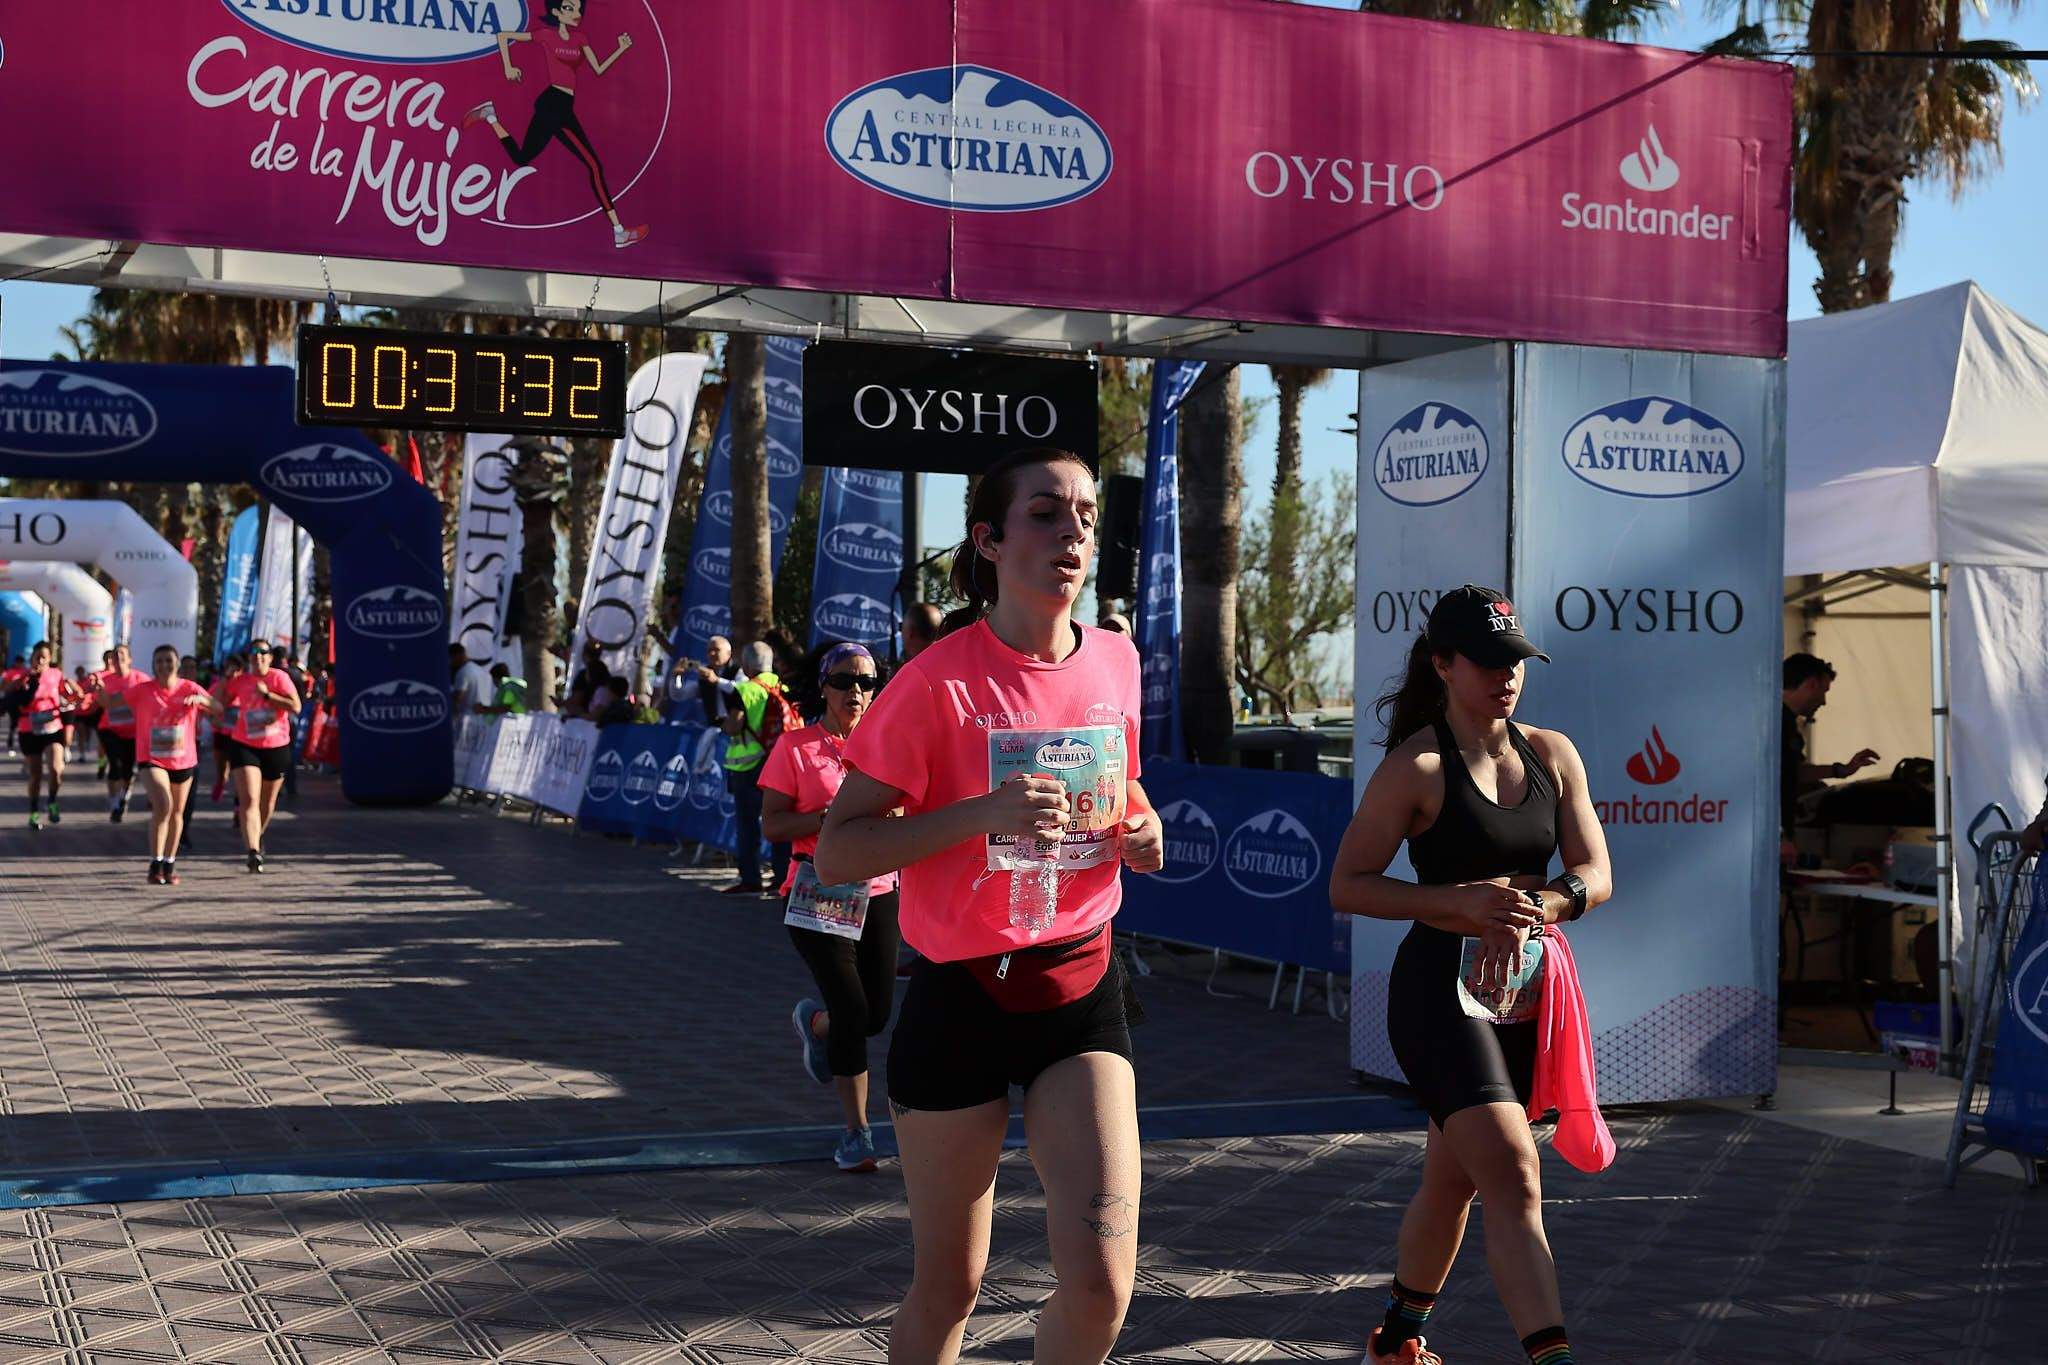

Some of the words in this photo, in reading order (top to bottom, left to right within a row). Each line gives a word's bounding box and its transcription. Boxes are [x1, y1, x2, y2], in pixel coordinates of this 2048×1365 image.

[187, 36, 445, 131] Carrera
[848, 109, 1090, 181] ASTURIANA
[894, 110, 983, 130] CENTRAL
[993, 119, 1082, 139] LECHERA
[250, 120, 298, 172] de
[309, 123, 345, 177] la
[336, 126, 537, 246] Mujer
[1245, 151, 1444, 211] OYSHO
[1561, 193, 1733, 241] Santander
[322, 342, 602, 419] 00:37:32
[0, 407, 140, 437] TURIANA
[853, 384, 1058, 439] OYSHO
[1575, 431, 1730, 474] ASTURIANA
[1603, 430, 1661, 442] CENTRAL
[1666, 432, 1725, 444] LECHERA
[270, 465, 384, 488] ASTURIANA
[1381, 446, 1480, 484] ASTURIANA
[585, 399, 679, 652] OYSHO
[115, 551, 167, 561] OYSHO
[1373, 589, 1453, 634] OYS
[1488, 615, 1518, 632] NY
[1555, 586, 1744, 635] OYSHO
[975, 711, 1037, 729] OYSHO
[1000, 745, 1025, 754] SUMA
[1039, 750, 1091, 763] ASTURIANA
[1593, 793, 1729, 824] antander
[1229, 839, 1308, 880] ASTURIANA
